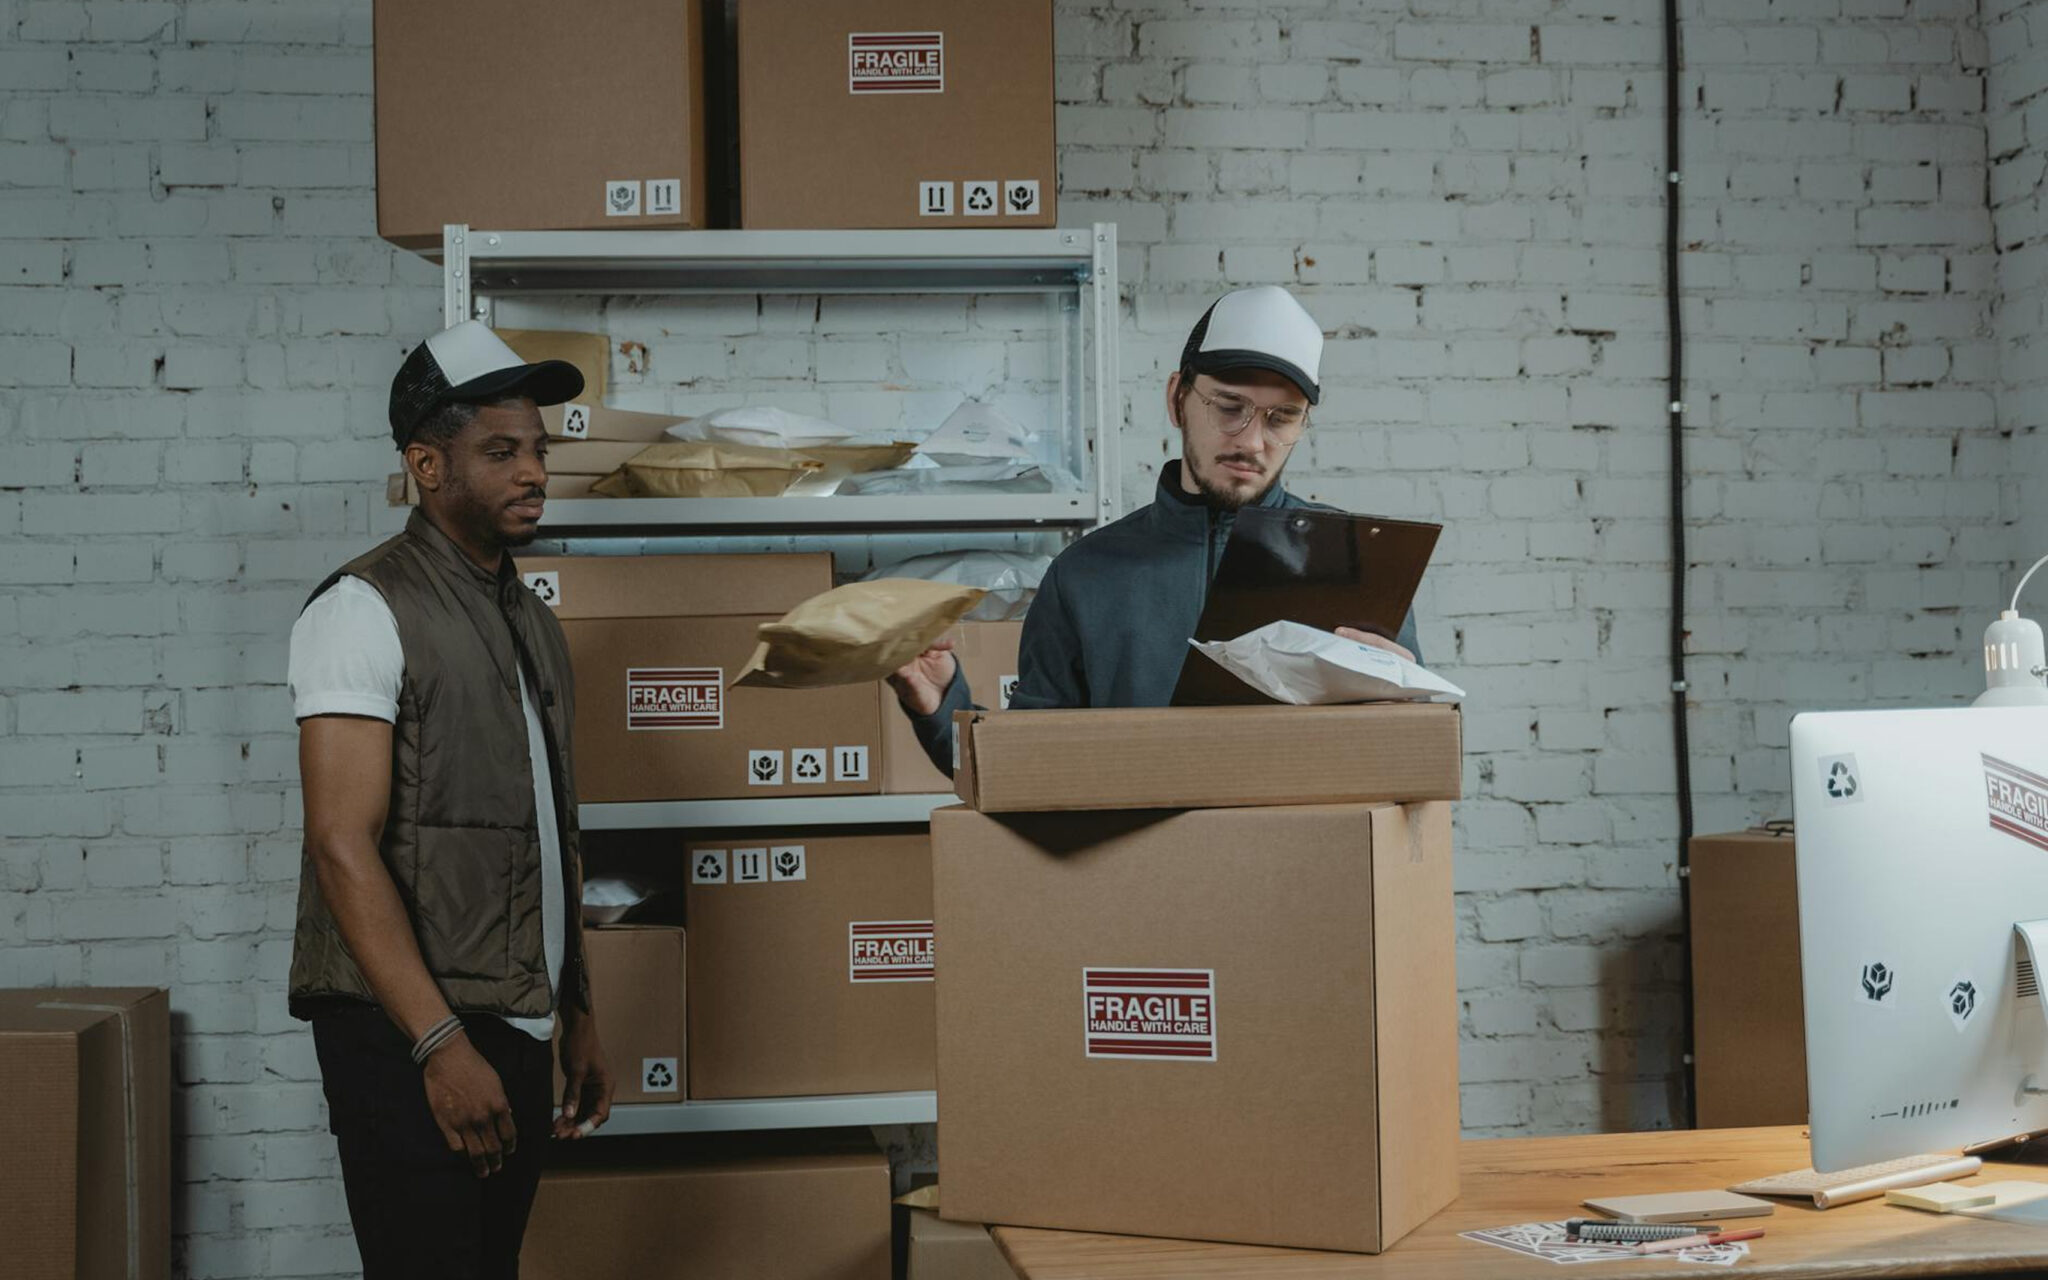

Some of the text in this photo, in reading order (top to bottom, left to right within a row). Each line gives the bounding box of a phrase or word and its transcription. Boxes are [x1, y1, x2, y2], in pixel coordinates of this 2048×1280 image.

[853, 51, 939, 68] FRAGILE
[854, 67, 938, 77] HANDLE WITH CARE
[631, 687, 718, 704] FRAGILE
[631, 703, 718, 712] HANDLE WITH CARE
[1990, 796, 2023, 819] HANDLE
[2023, 809, 2044, 828] WITH
[854, 956, 890, 965] HANDLE
[891, 956, 914, 964] WITH
[1088, 996, 1209, 1022] FRAGILE
[1090, 1020, 1209, 1034] HANDLE WITH CARE
